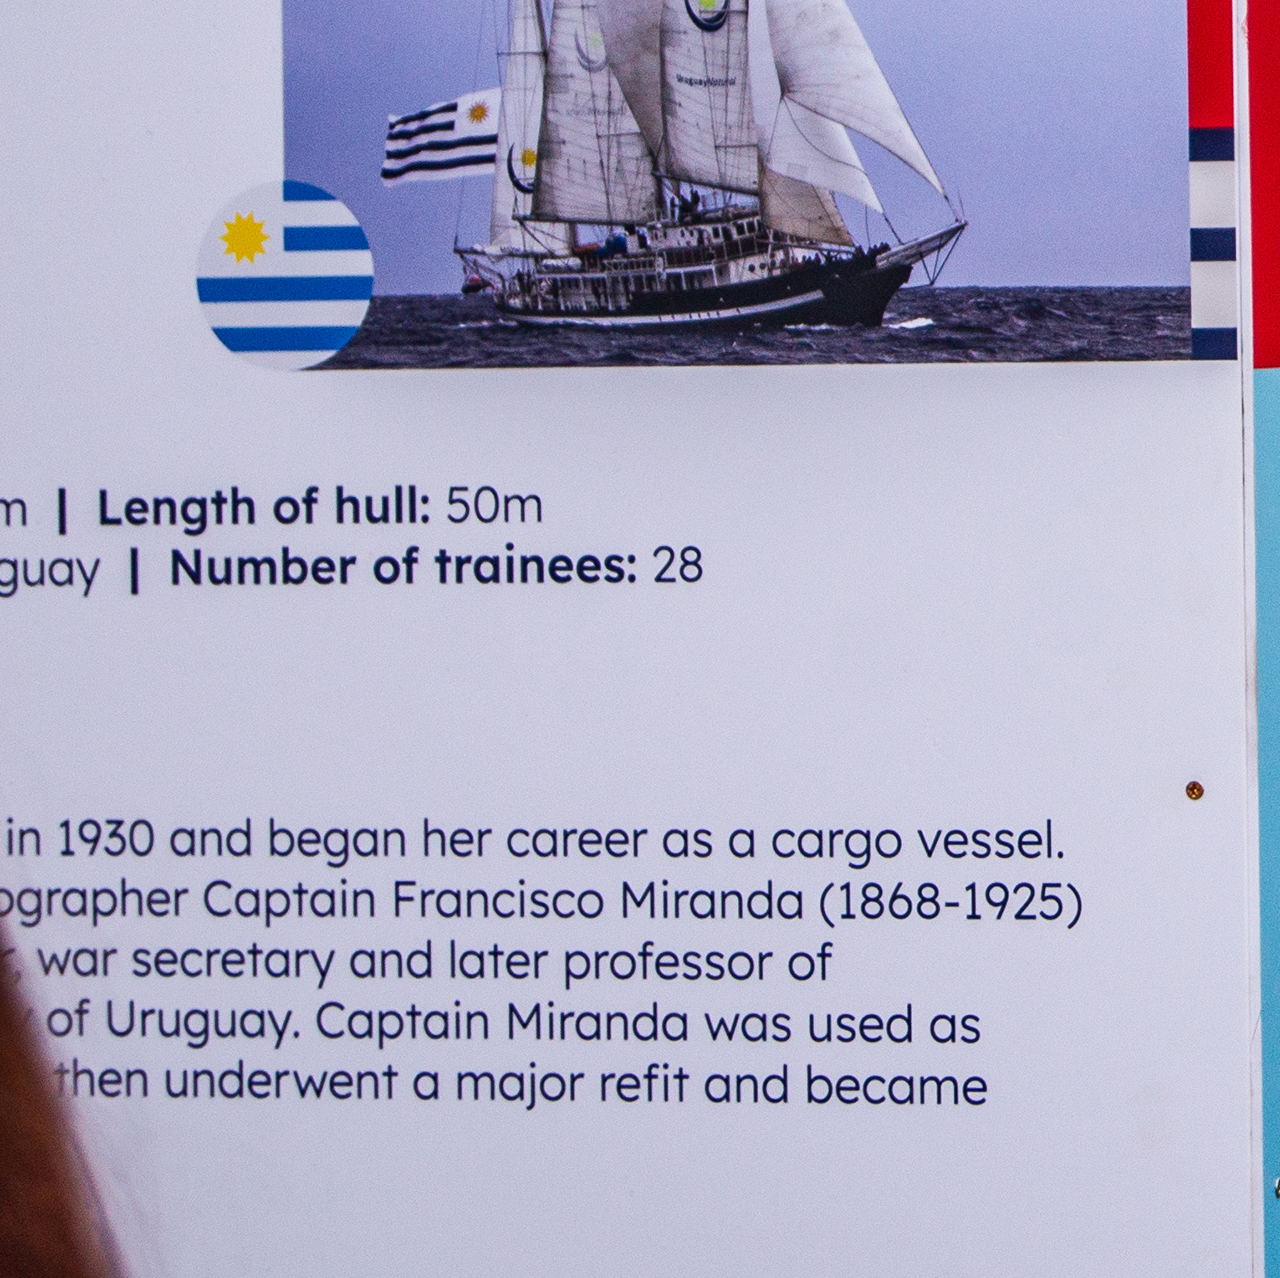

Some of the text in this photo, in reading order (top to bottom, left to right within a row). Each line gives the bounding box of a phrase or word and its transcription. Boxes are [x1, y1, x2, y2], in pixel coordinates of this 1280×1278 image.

[99, 488, 256, 537] Length
[273, 486, 319, 526] of
[336, 485, 429, 524] hull:
[447, 486, 543, 524] 50m
[171, 546, 357, 587] Number
[373, 545, 420, 585] of
[434, 543, 637, 585] trainees:
[653, 545, 704, 584] 28
[7, 817, 1064, 869] in 1930 and began her career as a cargo vessel.
[203, 878, 376, 928] Captain
[394, 879, 605, 920] Francisco
[622, 879, 804, 921] Miranda
[820, 882, 1083, 929] (1868-1925)
[37, 948, 119, 978] war
[132, 941, 336, 990] secretary
[350, 939, 433, 979] and
[450, 939, 550, 979] later
[565, 941, 774, 991] professor
[788, 941, 834, 981] of
[46, 997, 92, 1038] of
[107, 999, 300, 1050] Uruguay.
[316, 1000, 490, 1050] Captain
[508, 1001, 689, 1043] Miranda
[704, 1013, 792, 1043] was
[809, 1003, 913, 1044] used
[930, 1014, 981, 1044] as
[54, 1057, 988, 1112] then underwent a major refit and became
